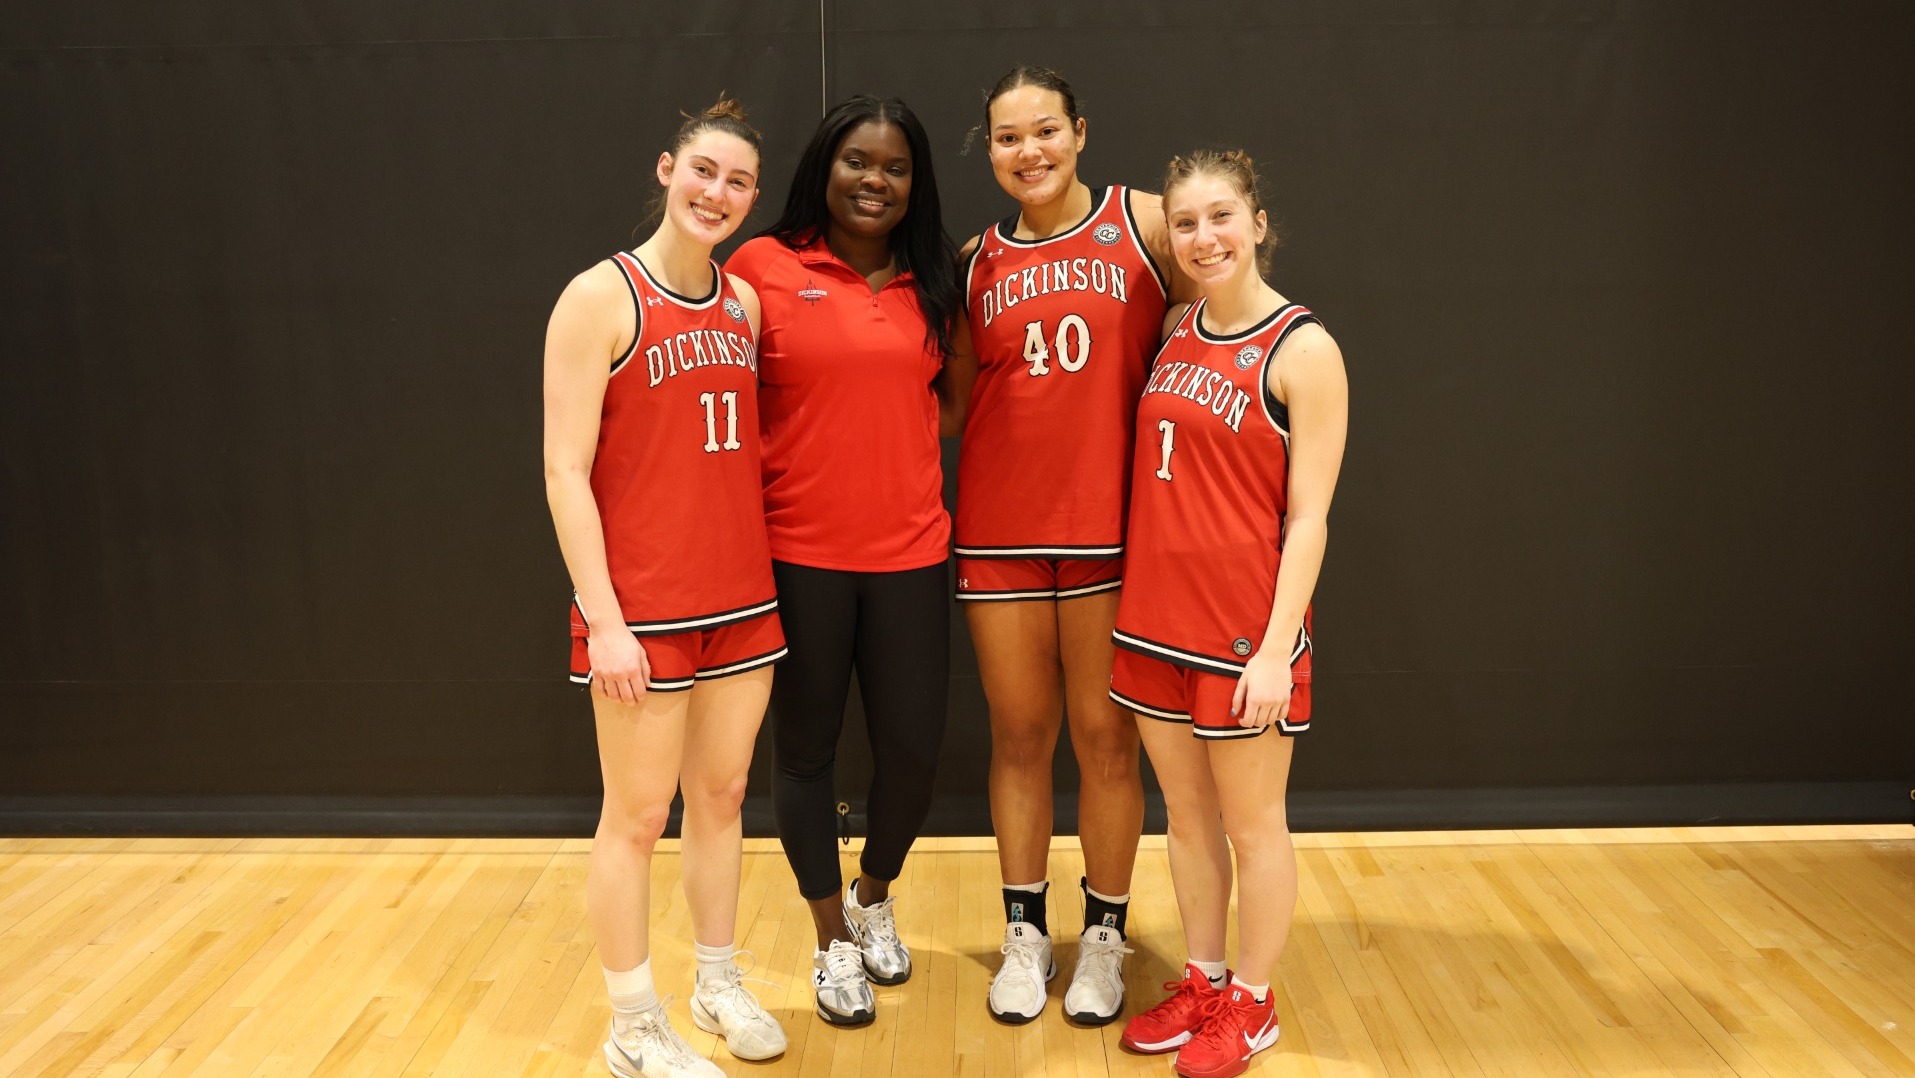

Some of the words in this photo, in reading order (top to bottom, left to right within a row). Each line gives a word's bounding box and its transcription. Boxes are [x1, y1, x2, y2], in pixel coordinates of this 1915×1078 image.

[982, 257, 1128, 328] DICKINSON
[1022, 313, 1094, 377] 40
[699, 391, 741, 453] 11
[1156, 419, 1177, 482] 1
